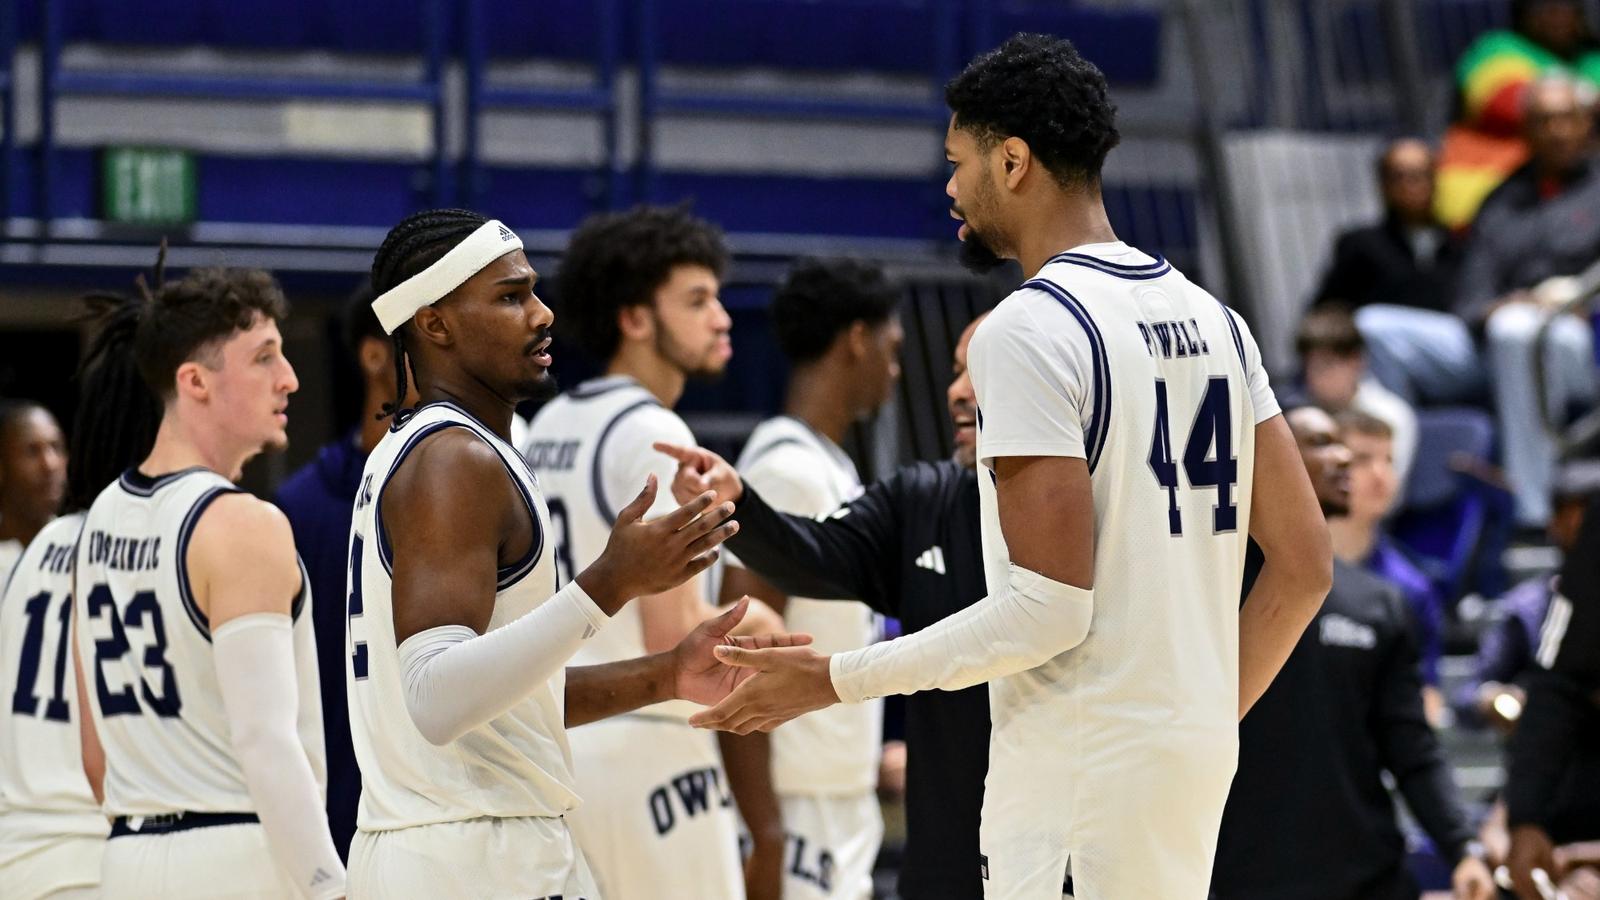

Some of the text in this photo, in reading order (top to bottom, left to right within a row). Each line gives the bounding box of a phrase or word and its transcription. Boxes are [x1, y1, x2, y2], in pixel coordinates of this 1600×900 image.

[1136, 318, 1210, 359] PWELL
[1146, 374, 1238, 538] 44
[12, 589, 74, 723] 11
[87, 583, 182, 718] 23
